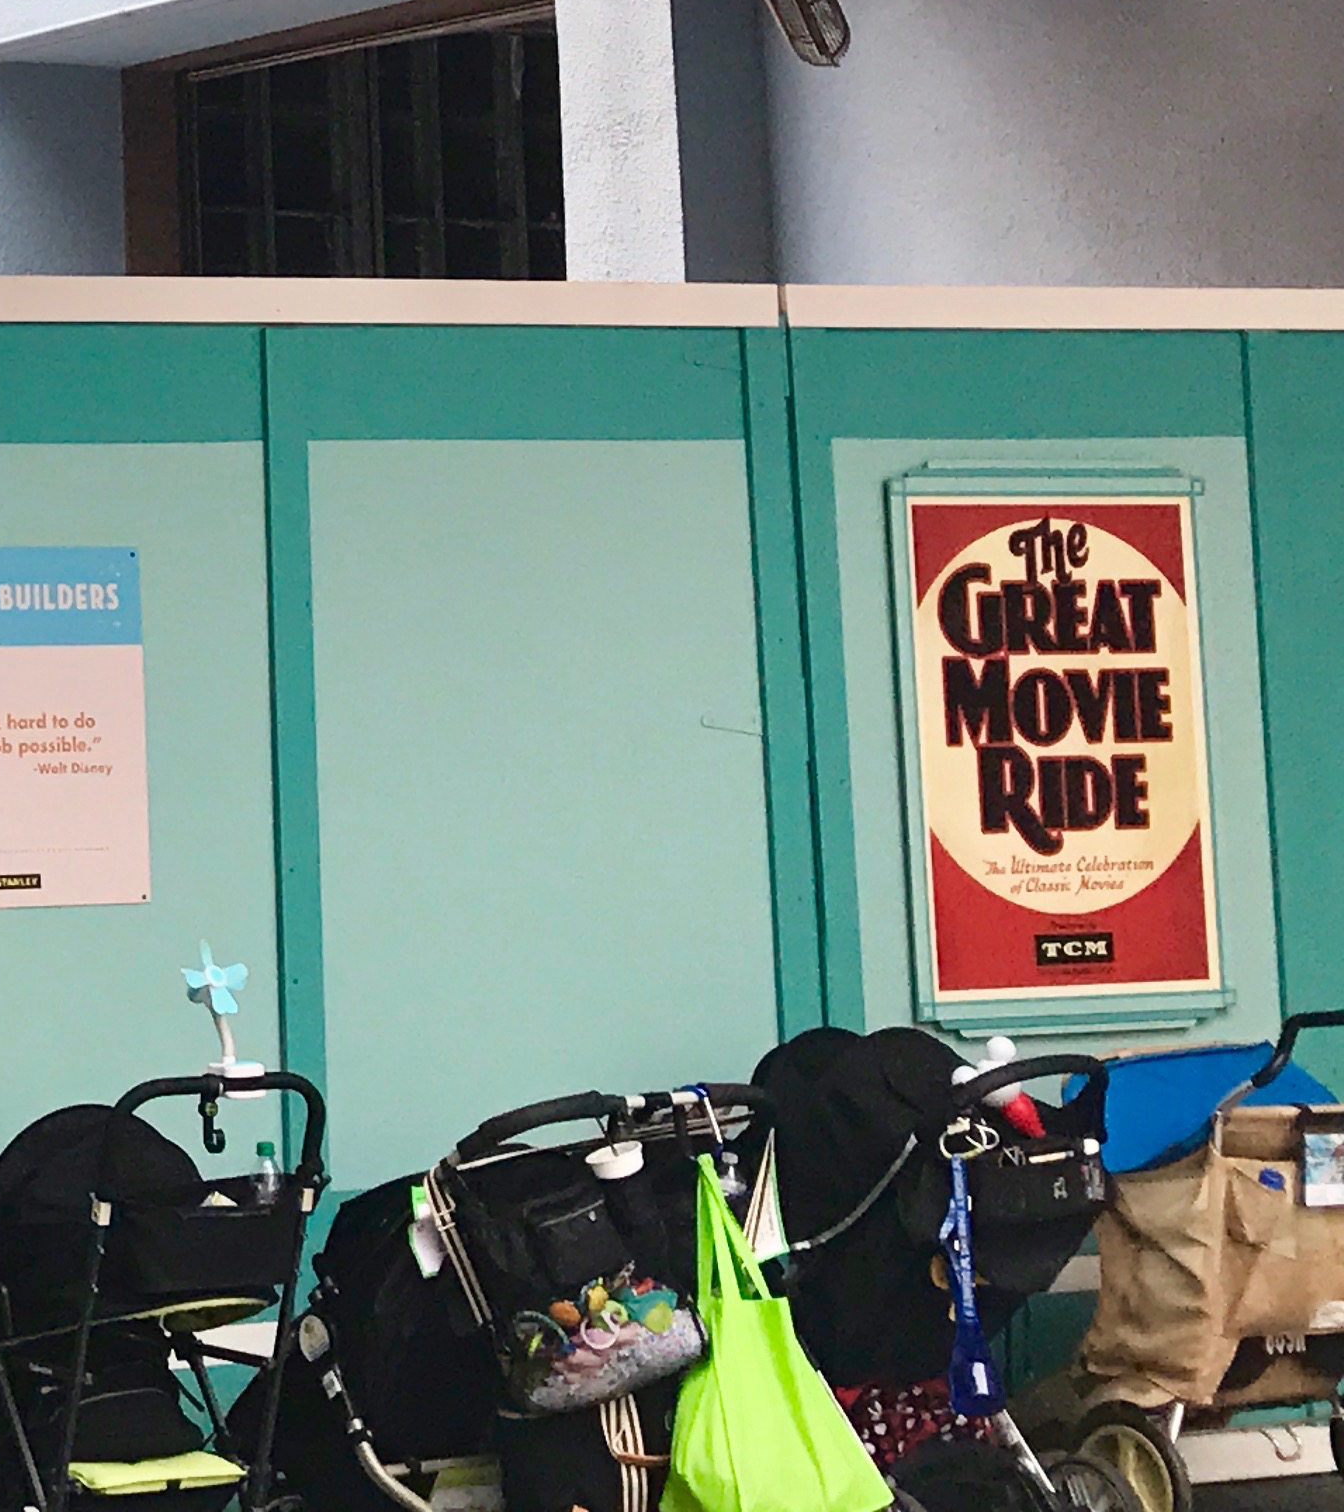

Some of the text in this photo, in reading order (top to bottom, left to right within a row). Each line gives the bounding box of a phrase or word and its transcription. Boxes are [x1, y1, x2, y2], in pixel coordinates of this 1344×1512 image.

[1008, 516, 1089, 584] The
[0, 583, 119, 610] BUILDERS
[937, 562, 1162, 658] GREAT
[942, 656, 1173, 747] MOVIE
[7, 712, 46, 729] hard
[52, 715, 68, 729] to
[74, 712, 95, 728] do
[19, 736, 101, 758] possible."
[34, 762, 112, 776] -Walt Disney
[976, 745, 1150, 856] RIDE
[1011, 855, 1071, 874] Ultimate
[1077, 856, 1154, 872] Celebration
[1026, 877, 1070, 892] Classic
[1075, 875, 1124, 895] Movies
[1042, 941, 1107, 957] TCM
